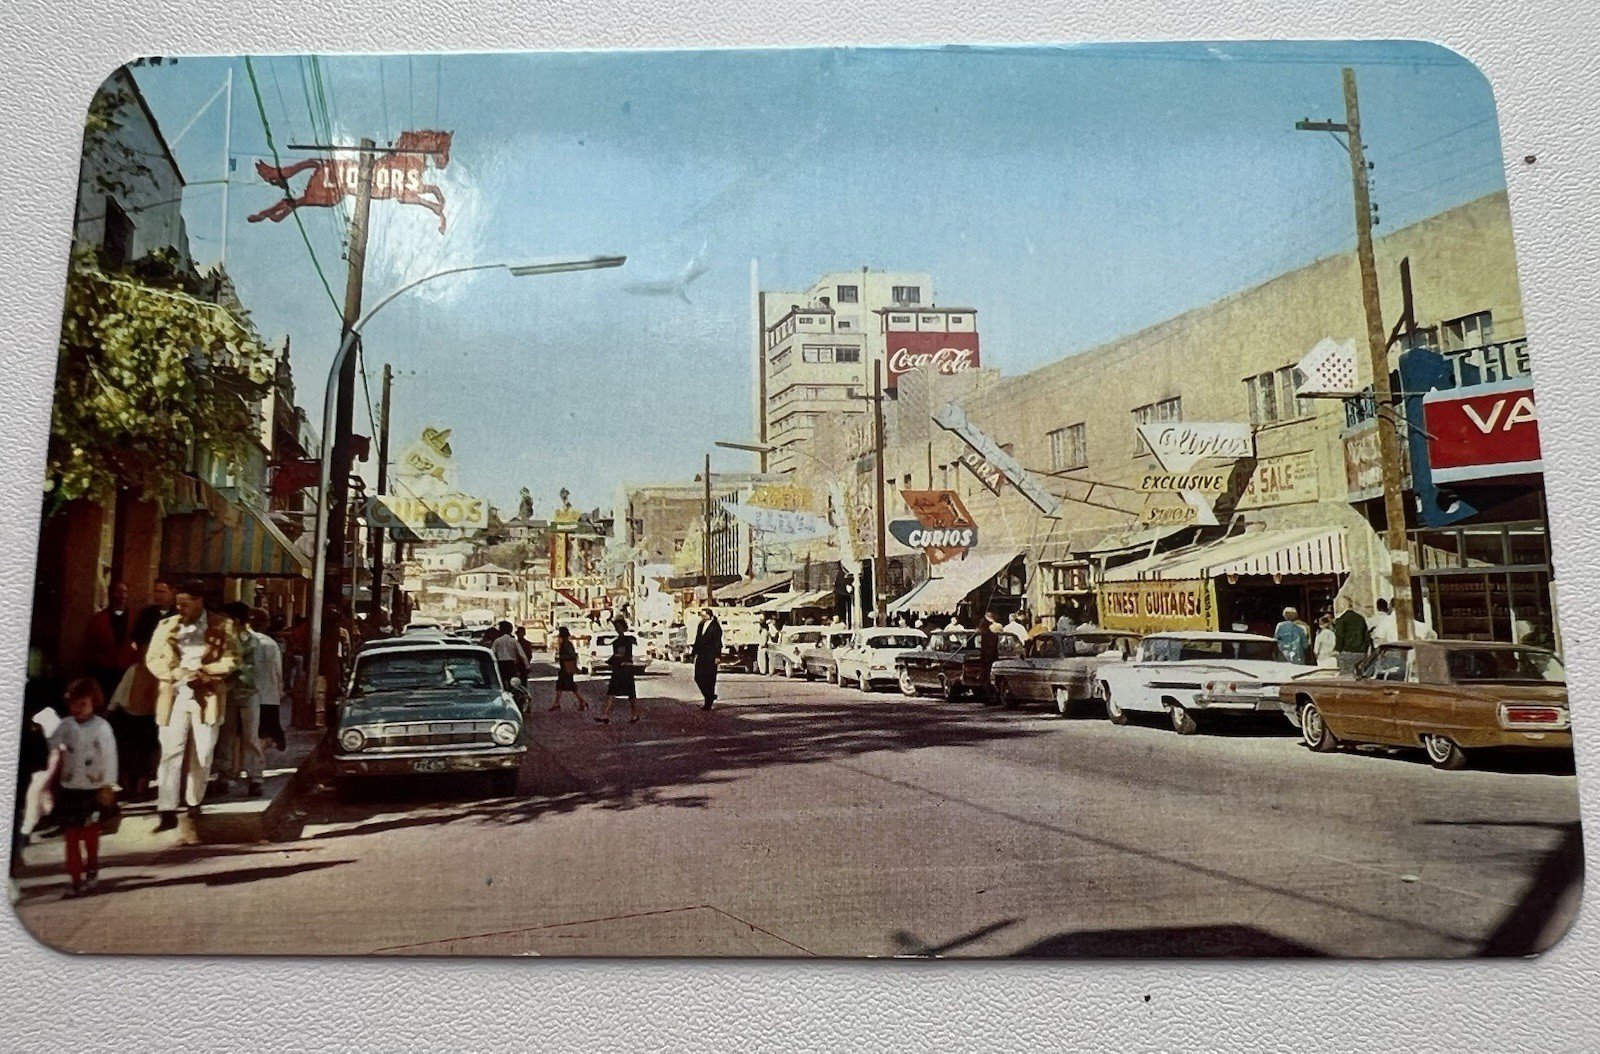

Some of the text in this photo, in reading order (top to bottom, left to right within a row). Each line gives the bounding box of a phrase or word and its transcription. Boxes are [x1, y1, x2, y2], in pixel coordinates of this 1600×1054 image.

[323, 166, 420, 192] LIQORS
[1443, 343, 1531, 389] THE
[1462, 397, 1538, 434] VA
[1142, 475, 1224, 491] EXCLUSIVE
[1260, 464, 1294, 494] SALE
[908, 528, 973, 547] CURIOS
[1107, 591, 1139, 614] FINEST
